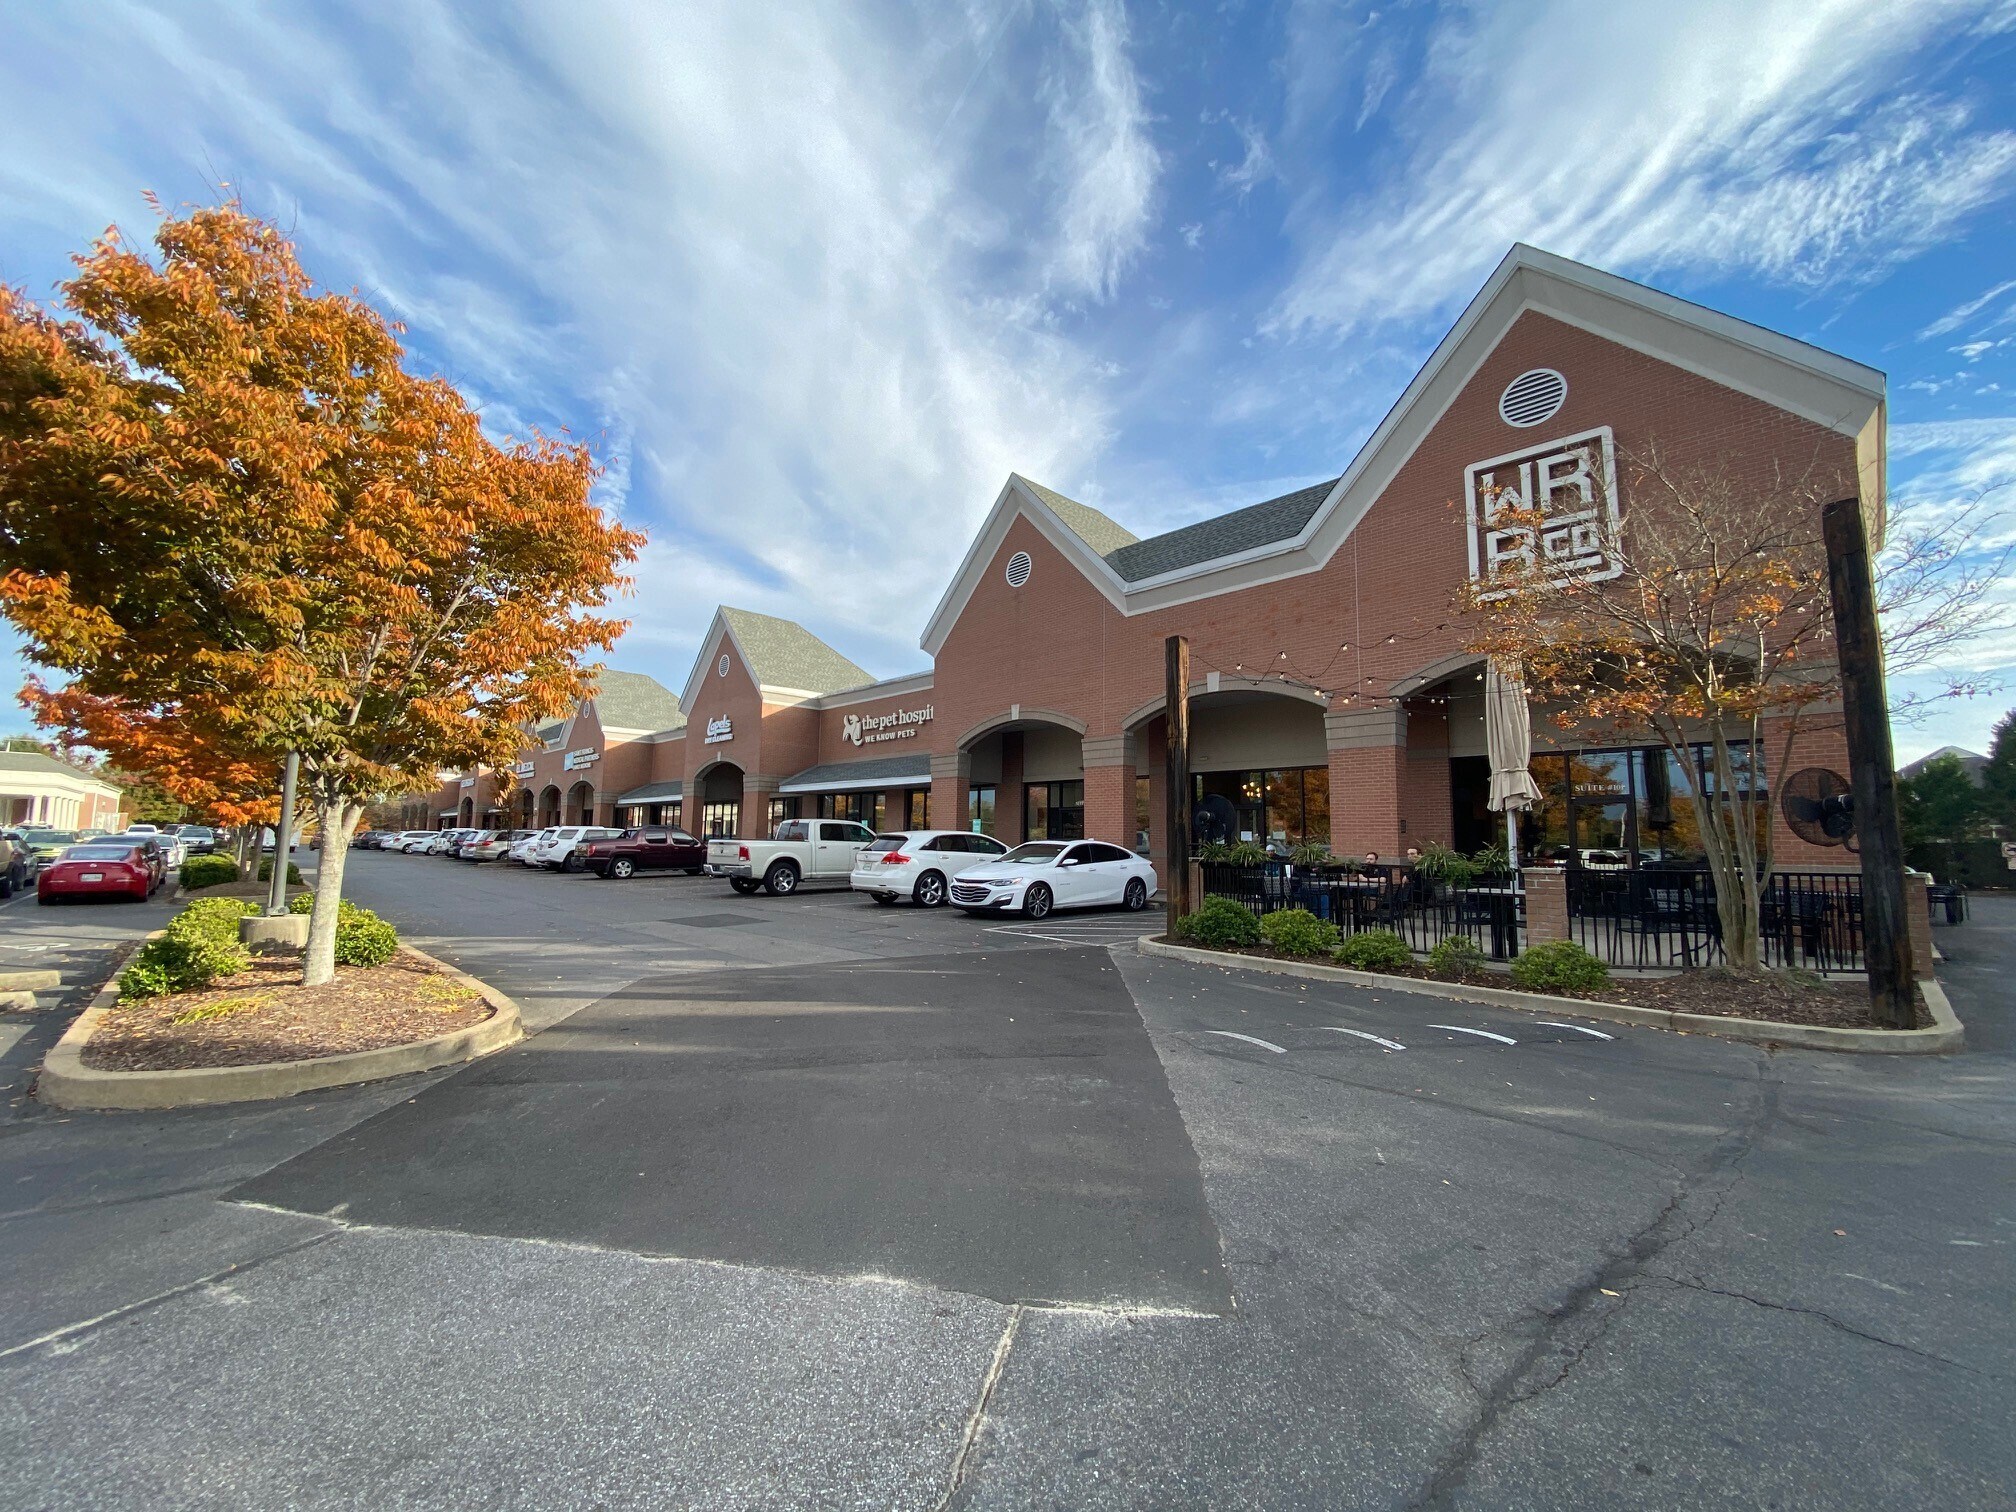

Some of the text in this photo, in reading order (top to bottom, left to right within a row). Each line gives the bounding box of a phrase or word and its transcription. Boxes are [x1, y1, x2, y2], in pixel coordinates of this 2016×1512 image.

[862, 714, 879, 731] the
[879, 712, 898, 731] pet
[865, 729, 915, 743] WE KNOW PETS
[1574, 784, 1605, 792] SUITE
